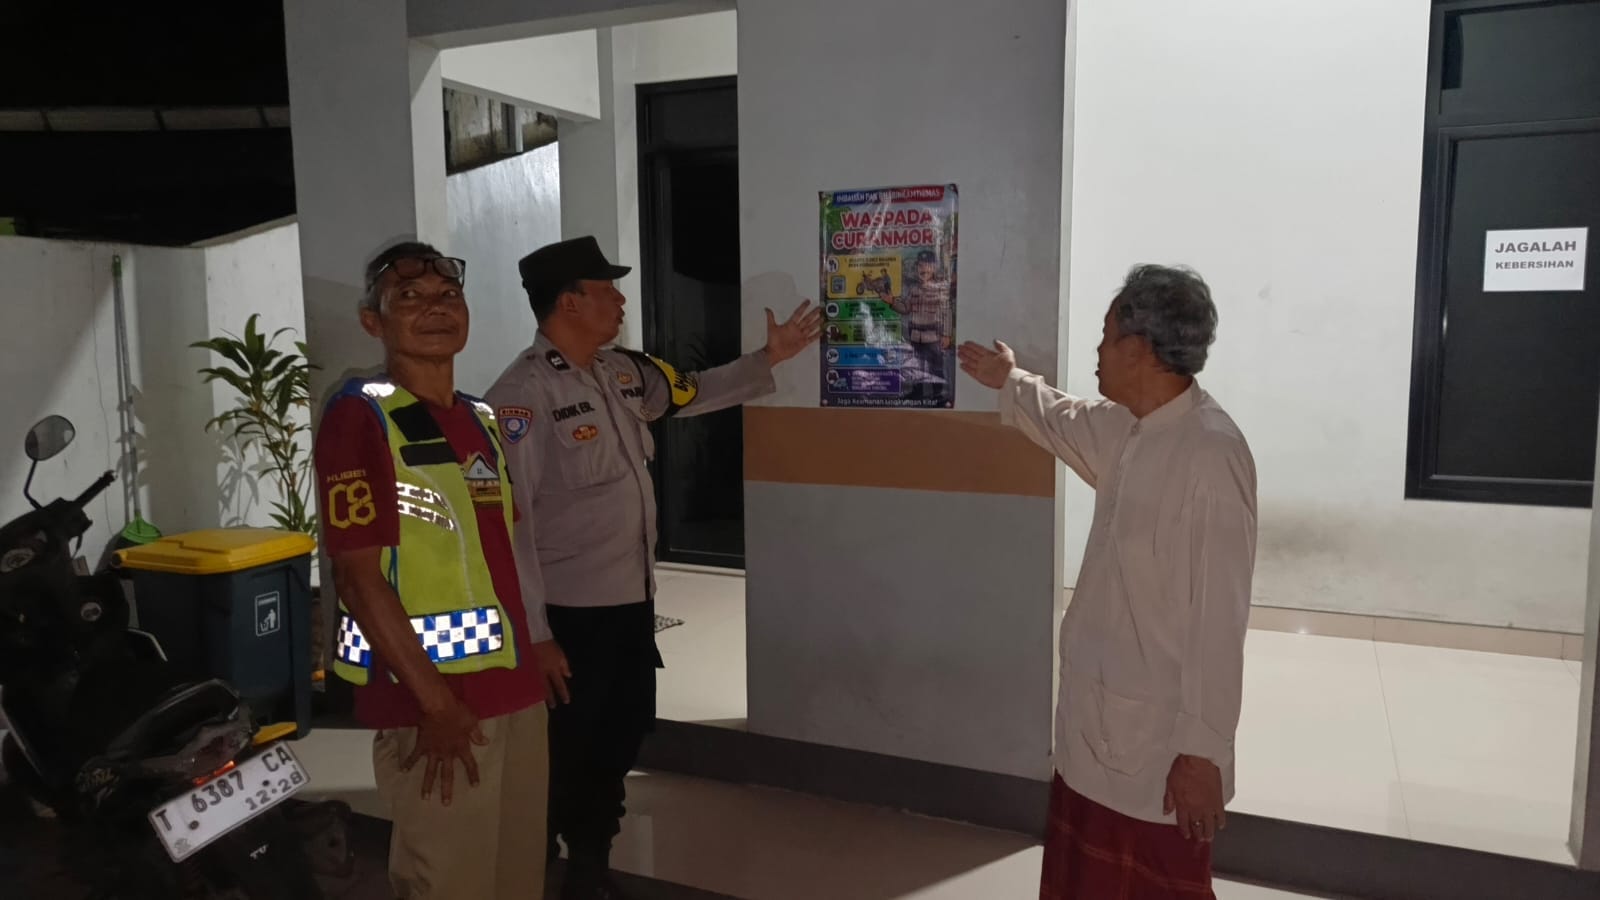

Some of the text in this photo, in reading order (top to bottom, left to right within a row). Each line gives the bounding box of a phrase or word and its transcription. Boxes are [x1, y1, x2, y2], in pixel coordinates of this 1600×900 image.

[841, 209, 933, 229] WASPADA
[832, 228, 934, 249] CURANMOR
[1495, 240, 1577, 253] JAGALAH
[1495, 260, 1574, 270] KEBERSIHAN
[552, 404, 581, 422] DIDIK
[328, 479, 377, 529] C8
[155, 746, 293, 832] T 6387 CA
